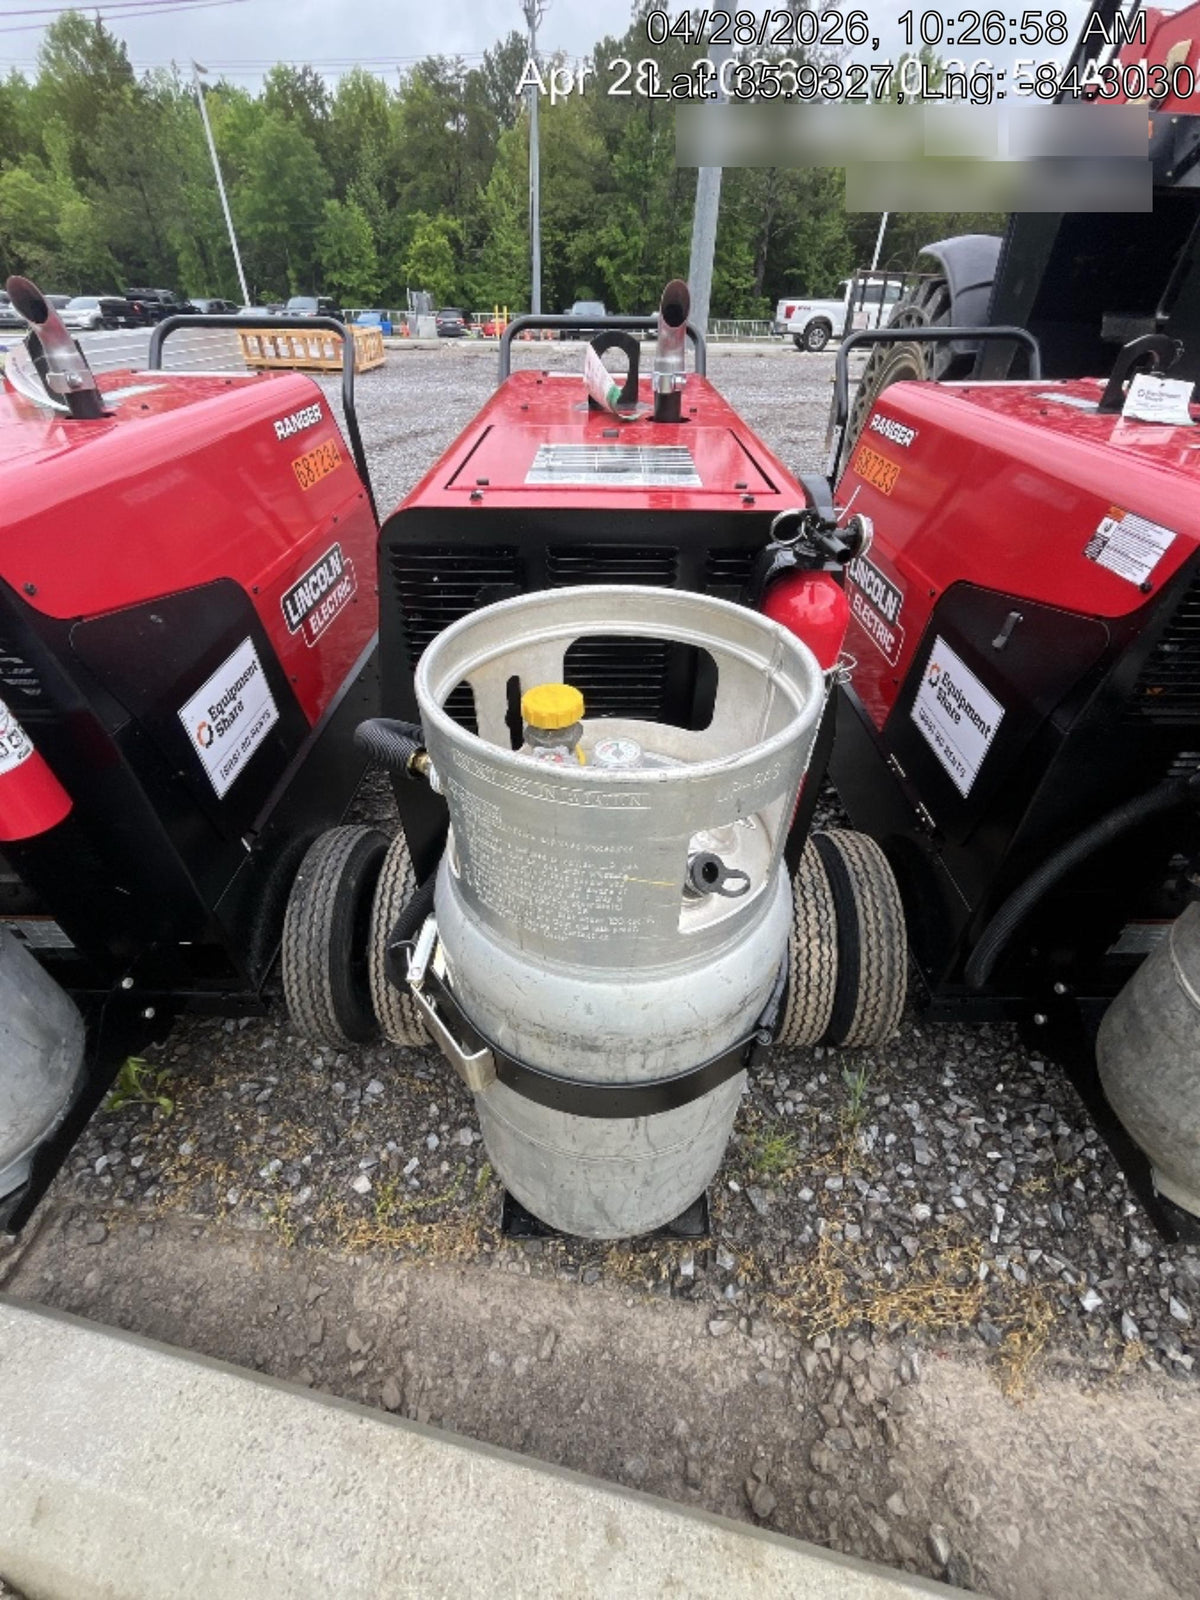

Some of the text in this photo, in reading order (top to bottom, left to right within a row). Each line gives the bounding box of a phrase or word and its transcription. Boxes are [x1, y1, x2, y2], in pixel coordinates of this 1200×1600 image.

[273, 402, 323, 441] RANGER
[869, 413, 910, 448] RANGER
[285, 550, 342, 625] LINCOLN
[308, 575, 352, 636] ELECTRIC
[849, 558, 899, 622] LINCOLN
[852, 593, 896, 654] ELECTRIC
[207, 659, 259, 723] Equipment
[213, 700, 245, 739] Share
[935, 686, 962, 726] Share
[941, 671, 992, 740] Equipment
